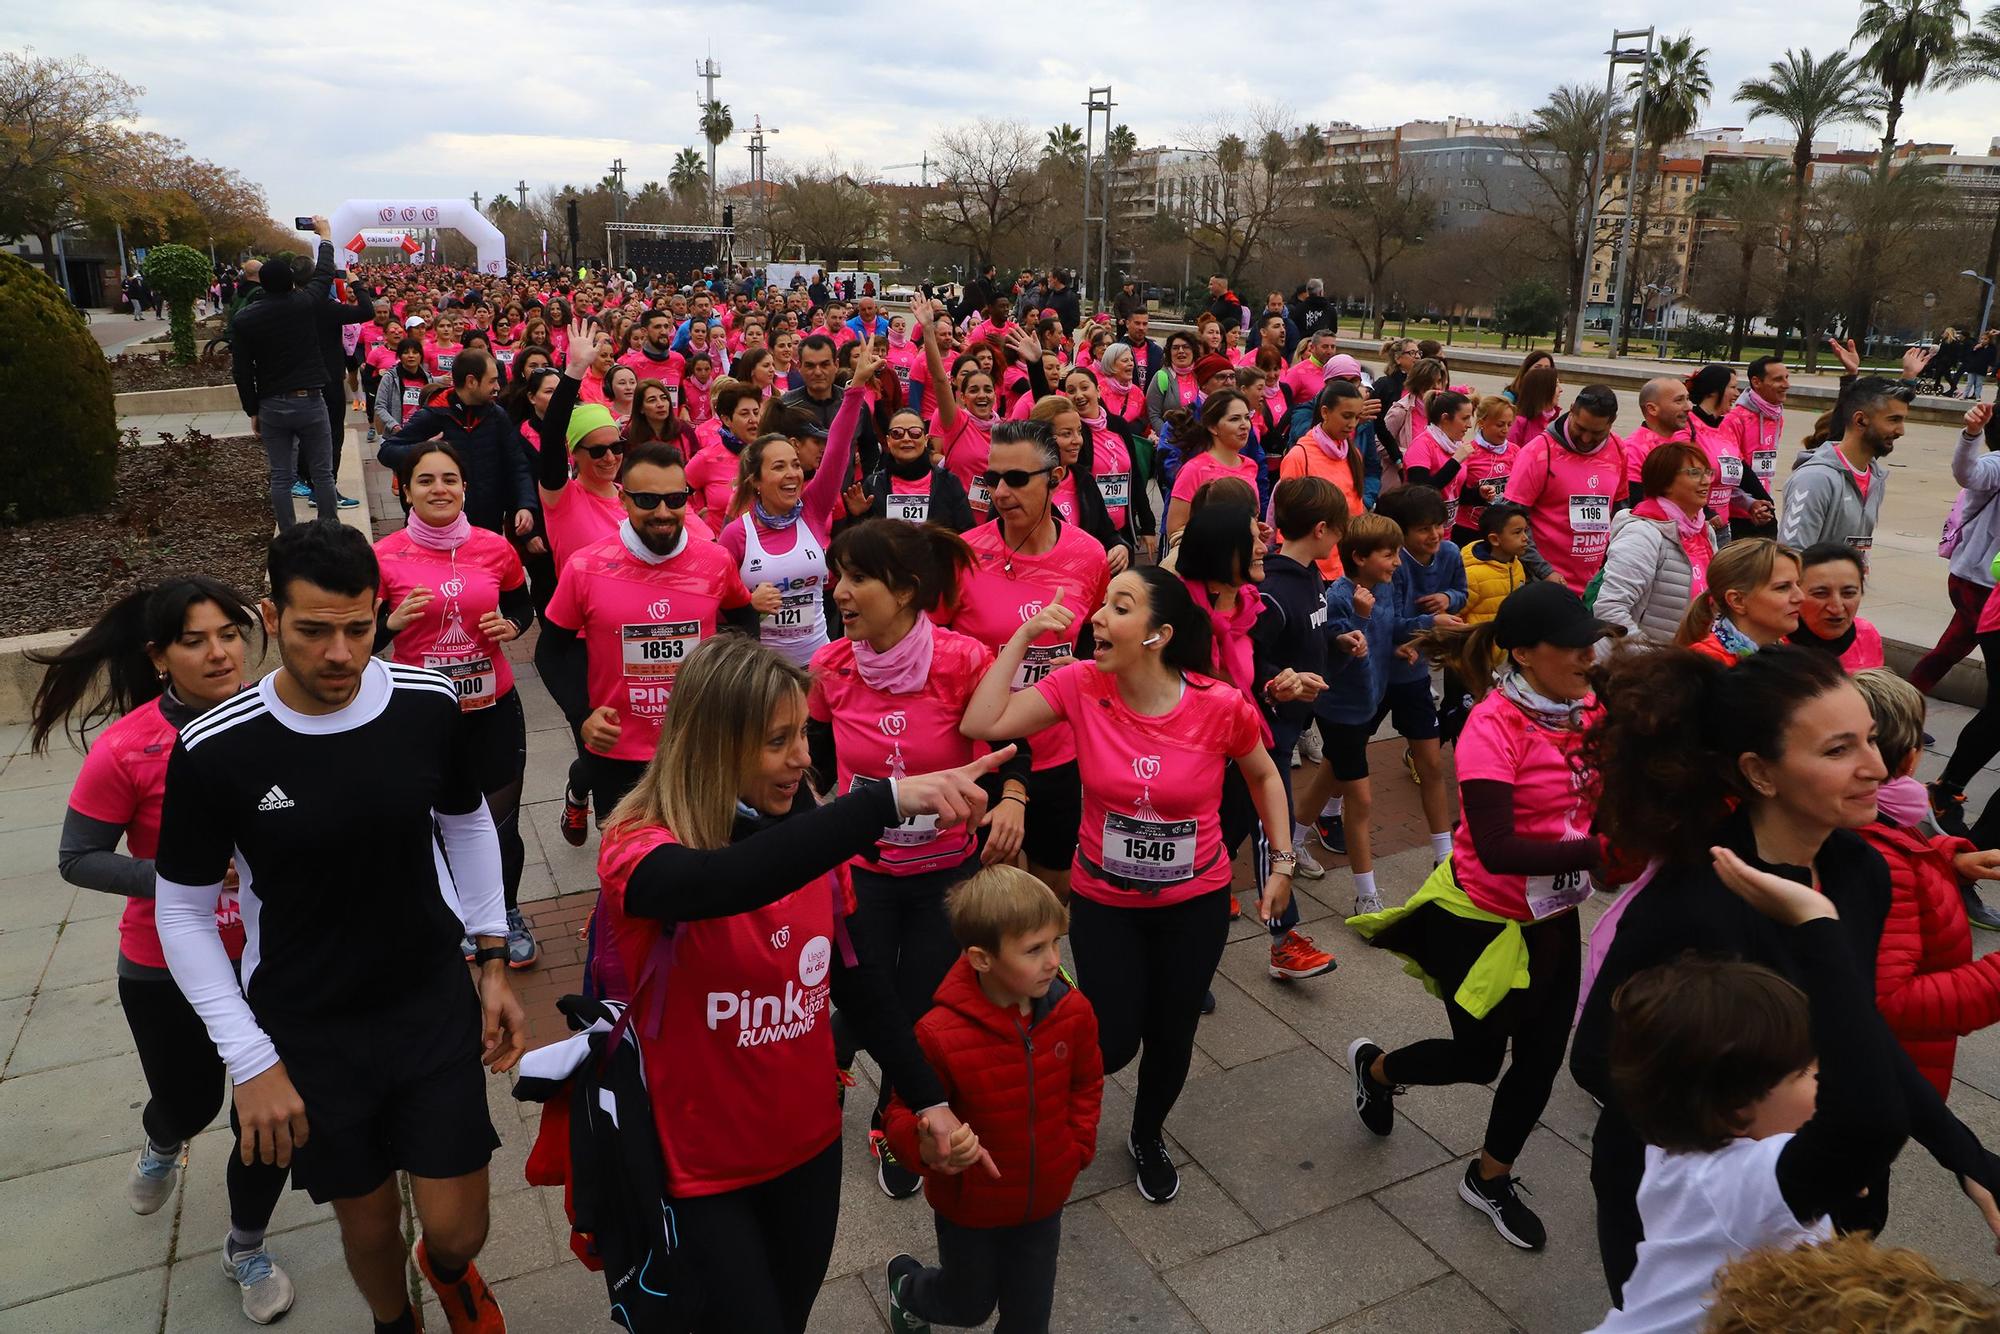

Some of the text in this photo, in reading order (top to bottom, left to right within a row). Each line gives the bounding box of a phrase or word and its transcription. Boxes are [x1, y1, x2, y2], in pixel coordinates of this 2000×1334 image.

[367, 235, 393, 245] cajasur
[1105, 484, 1122, 496] 2197
[902, 506, 923, 519] 621
[1581, 507, 1601, 520] 1196
[1573, 532, 1607, 546] PINK
[775, 609, 801, 624] 1121
[1309, 607, 1328, 630] PUM
[640, 640, 684, 659] 1853
[1023, 664, 1051, 683] 715
[629, 687, 672, 703] PIN
[257, 799, 295, 812] adidas
[1123, 838, 1176, 862] 1546
[1552, 870, 1581, 890] 819
[707, 980, 804, 1031] Pink
[804, 997, 825, 1017] 2022
[736, 1013, 815, 1048] RUNNING
